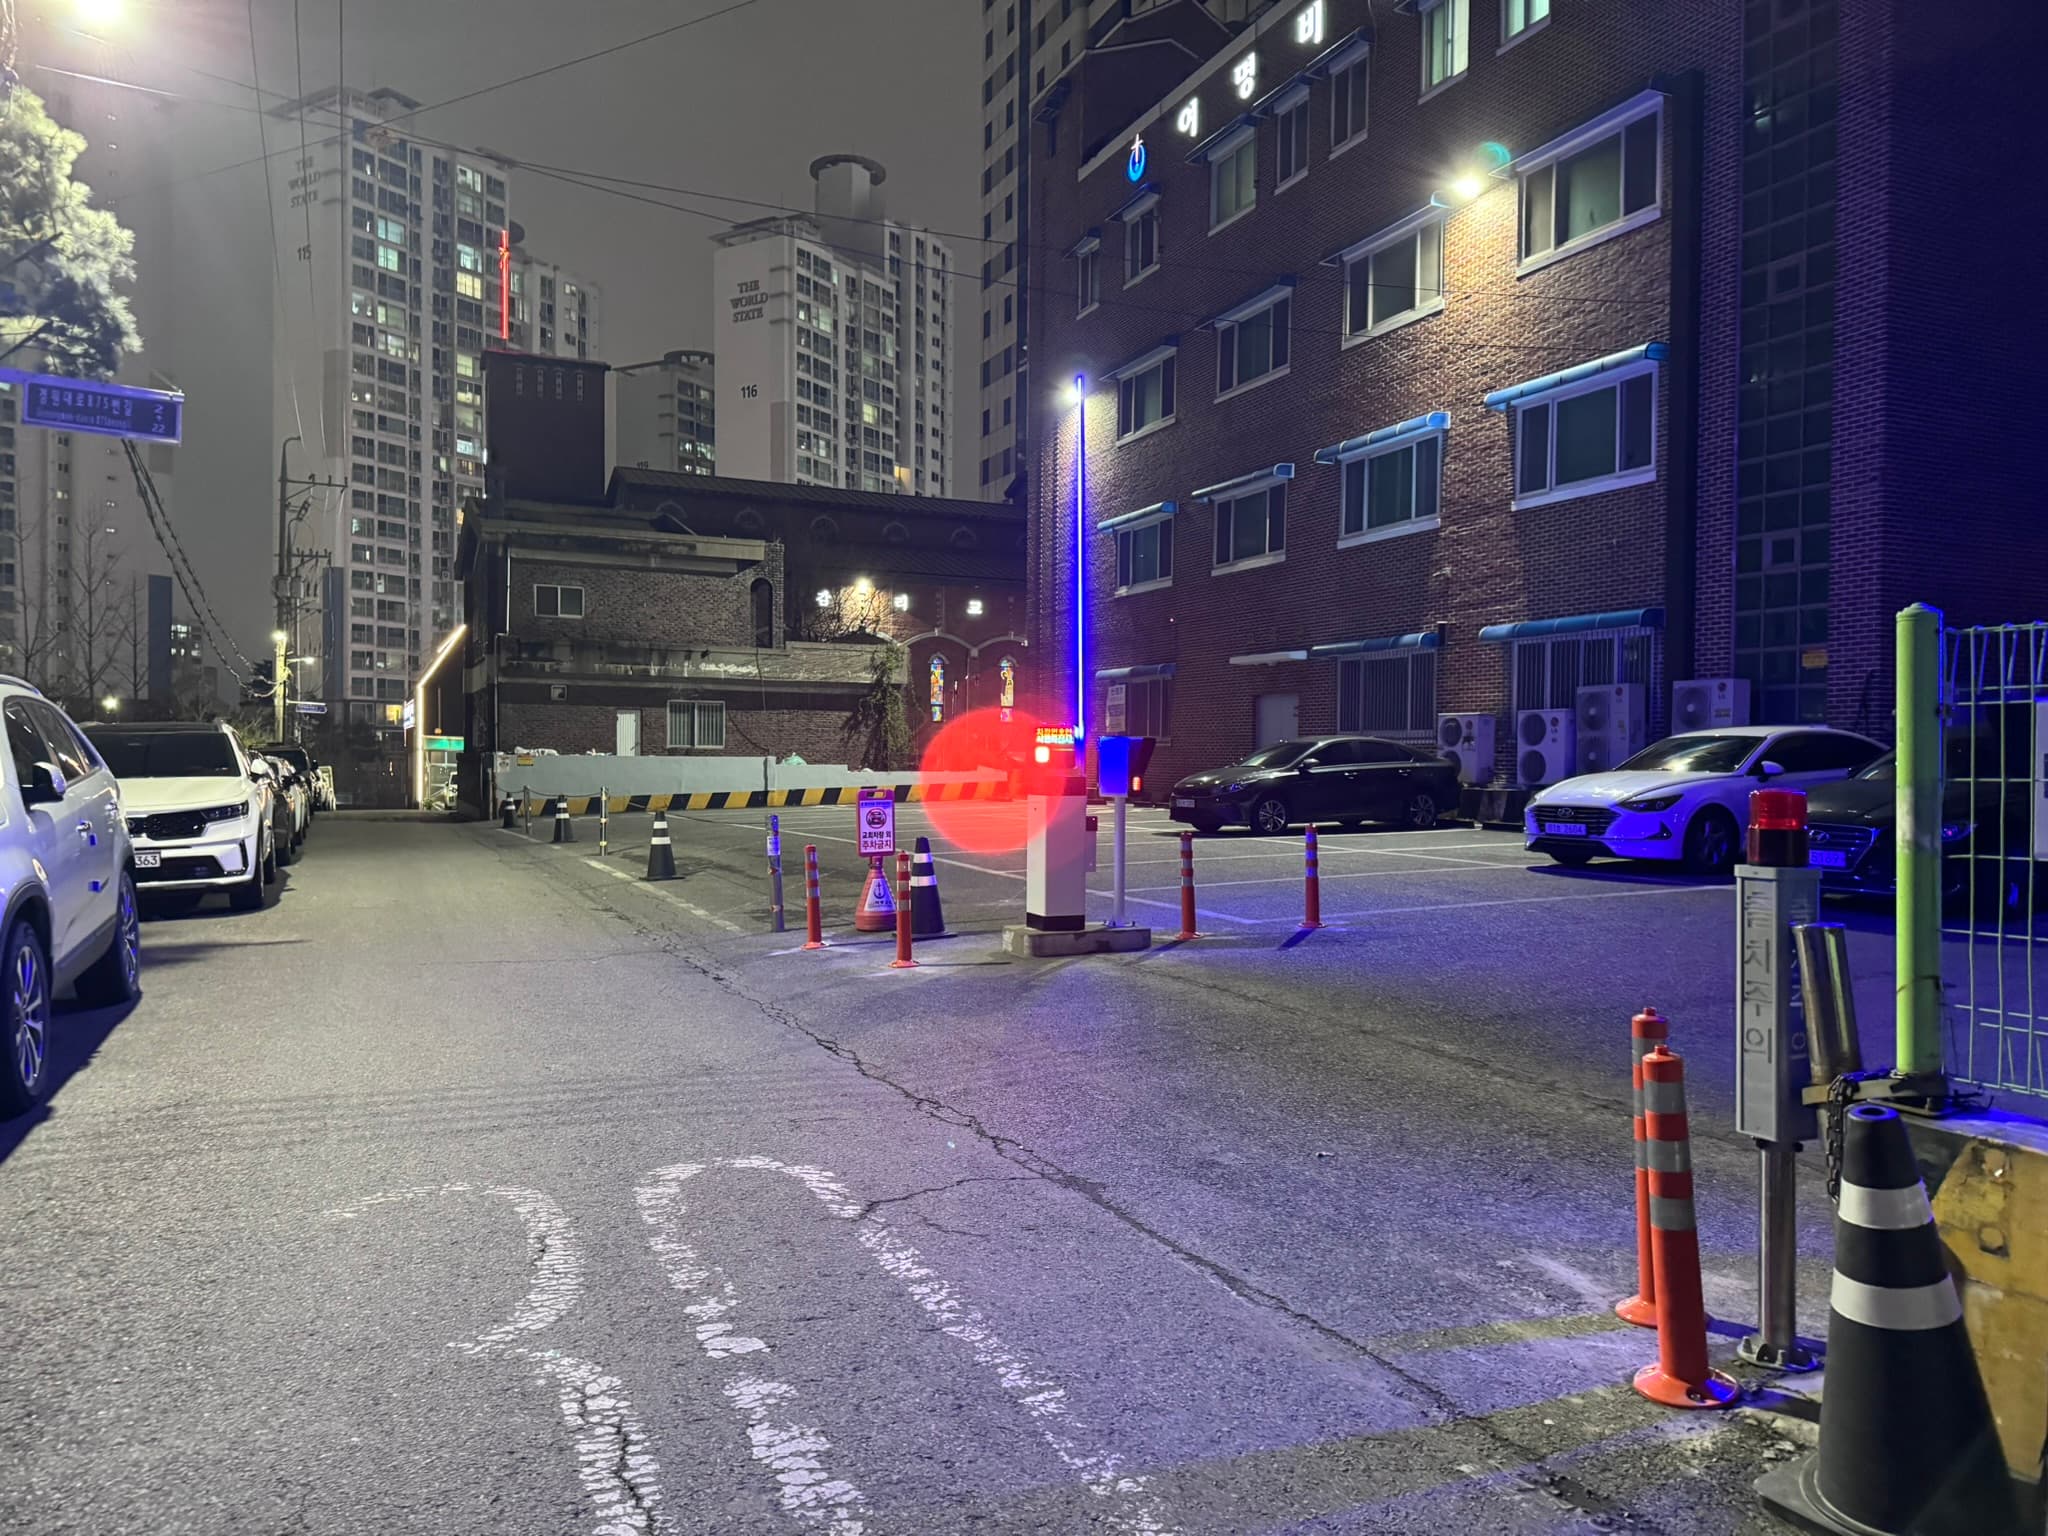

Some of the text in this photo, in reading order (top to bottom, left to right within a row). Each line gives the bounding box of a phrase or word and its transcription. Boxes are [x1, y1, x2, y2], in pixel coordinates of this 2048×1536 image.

[737, 280, 760, 294] THE
[730, 292, 769, 309] WORLD
[732, 307, 764, 323] STATE
[740, 384, 758, 398] 116
[154, 404, 164, 414] 2
[151, 423, 166, 434] 22
[862, 831, 885, 839] 교회차량
[862, 839, 892, 850] 주차금지
[135, 855, 158, 866] 363
